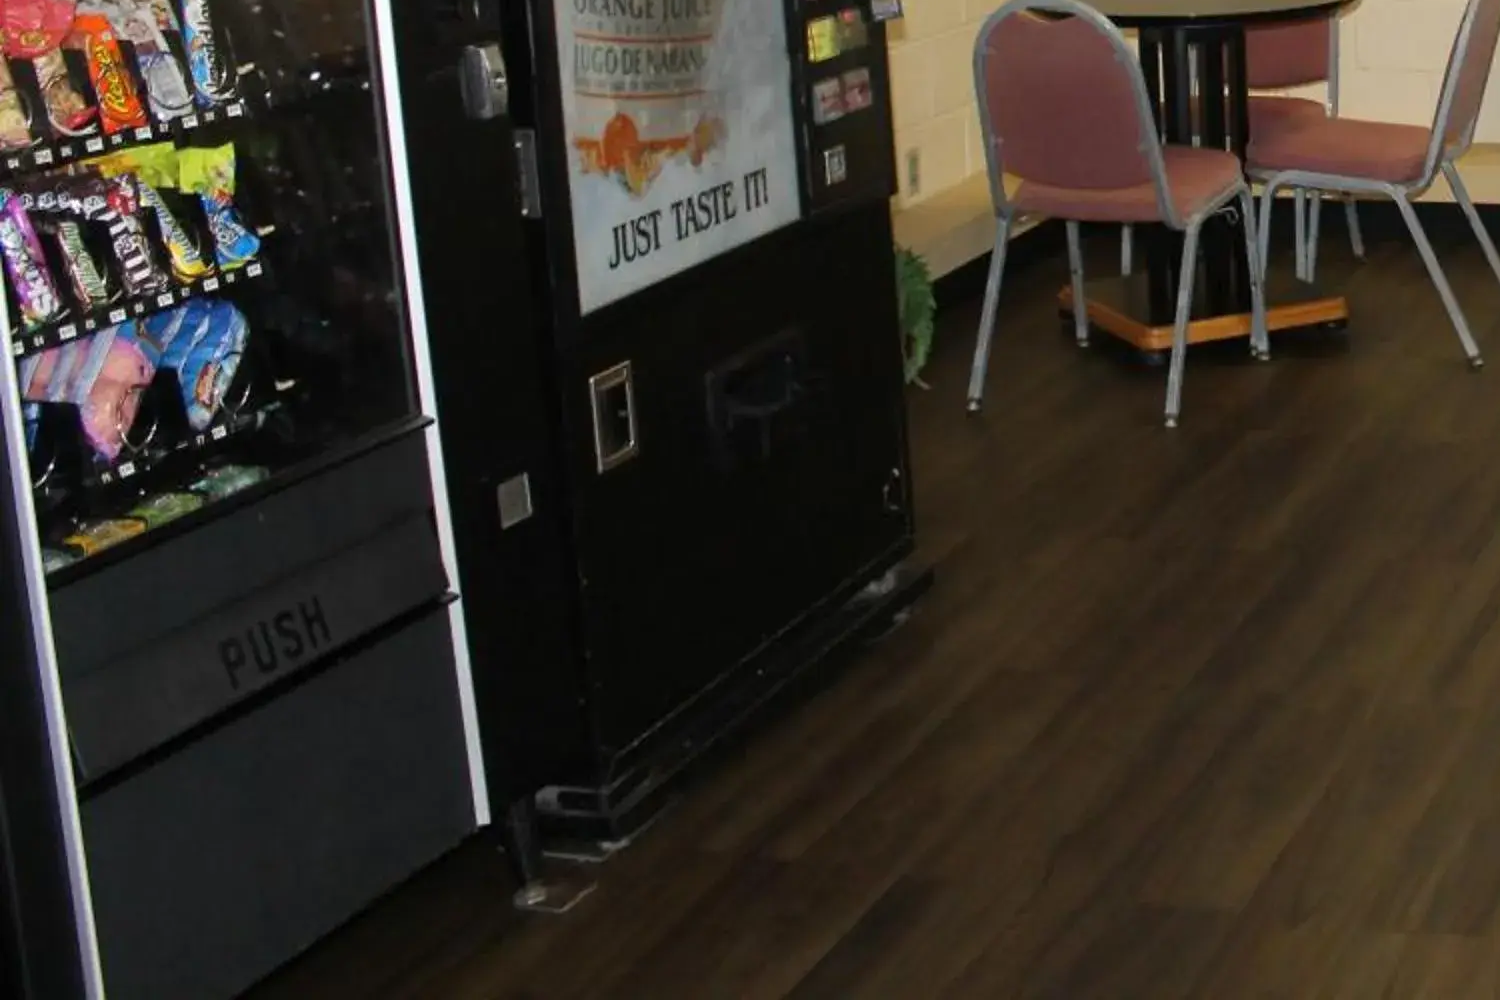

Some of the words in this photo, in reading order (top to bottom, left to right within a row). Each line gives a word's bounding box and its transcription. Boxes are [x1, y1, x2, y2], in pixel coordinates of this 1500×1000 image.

[574, 42, 618, 77] JUGO
[621, 47, 642, 76] DE
[609, 209, 662, 270] JUST
[670, 180, 737, 241] TASTE
[743, 167, 769, 213] IT!
[218, 593, 332, 691] PUSH
